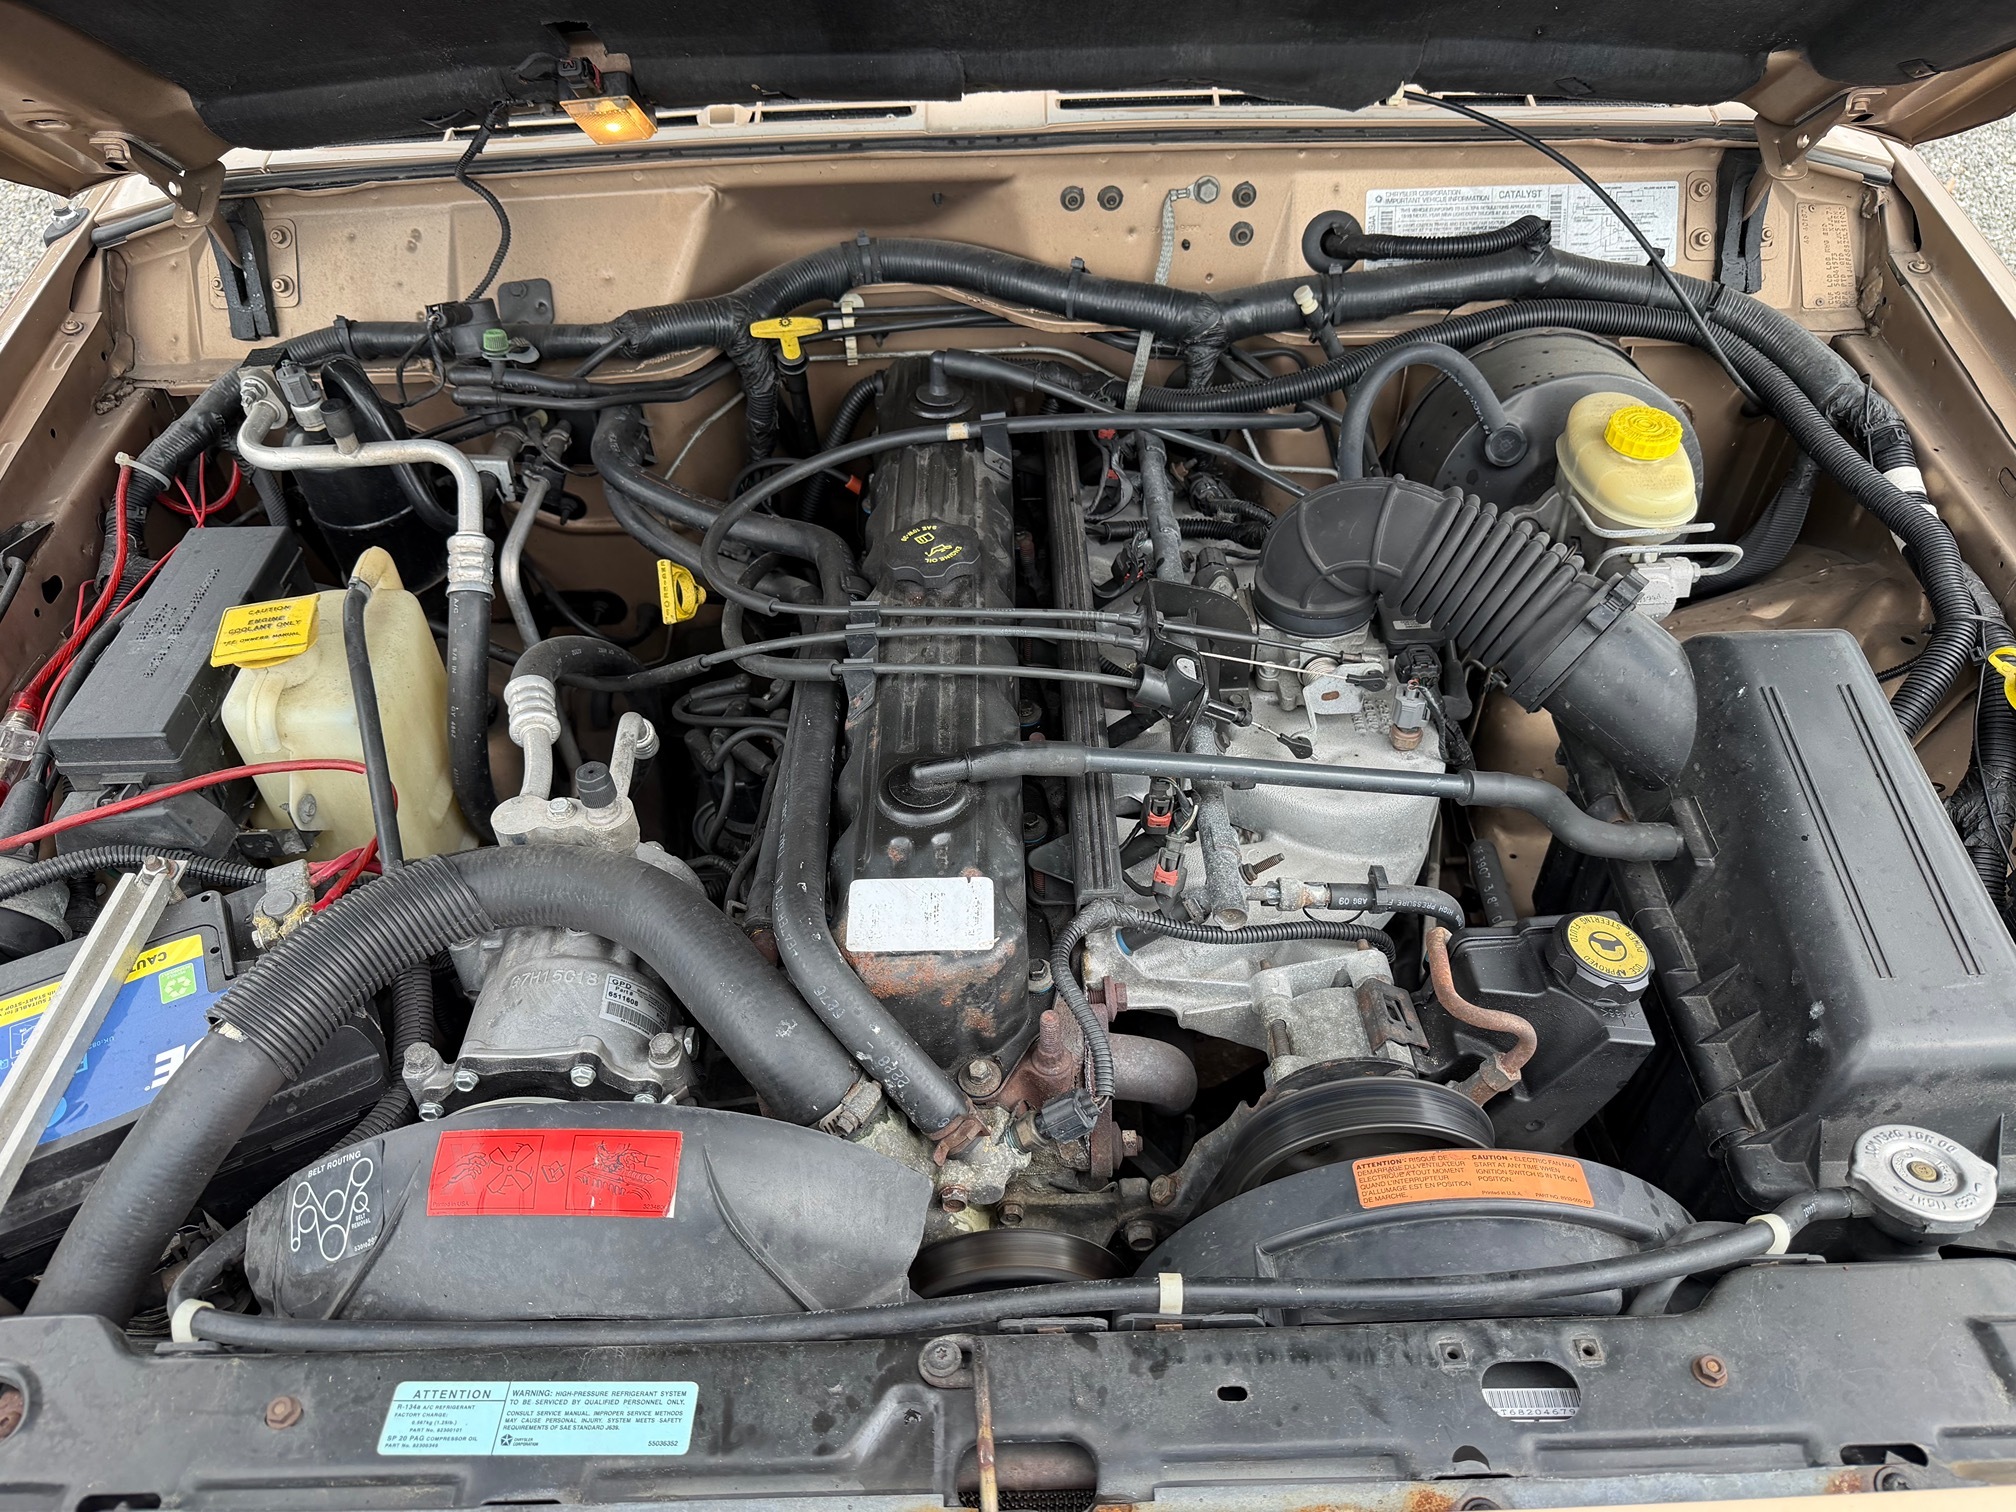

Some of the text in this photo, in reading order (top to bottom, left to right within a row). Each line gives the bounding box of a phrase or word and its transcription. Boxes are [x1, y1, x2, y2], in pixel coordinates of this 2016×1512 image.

[1446, 194, 1490, 202] INFORMATION
[1498, 190, 1542, 199] CATALYST
[938, 546, 963, 562] ENGINE
[248, 605, 293, 616] CAUTION
[247, 615, 286, 625] ENGINE
[228, 619, 302, 635] COOLANT ONLY
[239, 635, 270, 643] OWNERS
[272, 631, 301, 639] MANUAL
[1399, 900, 1436, 909] PRESSURE
[1438, 905, 1454, 915] HIGH
[1569, 917, 1645, 953] POWER STEERING FLUID
[1583, 955, 1644, 976] USE APPROVED
[611, 978, 632, 990] GPD
[608, 990, 639, 1007] 6511608
[1907, 1131, 1935, 1145] NOT
[1937, 1140, 1958, 1154] DO
[307, 1150, 361, 1178] BELT ROUTING
[1513, 1156, 1548, 1165] ELECTRIC
[1357, 1165, 1404, 1177] DEMARRAGE
[1415, 1160, 1466, 1169] VENTILATEUR
[1508, 1169, 1536, 1177] SWITCH
[1539, 1165, 1561, 1174] WHEN
[1358, 1171, 1405, 1184] ELECTRIQUE
[1360, 1174, 1450, 1190] QUAND L'INTERRUPTEUR
[1361, 1185, 1408, 1197] D'ALLUMAGE
[1436, 1180, 1472, 1188] POSITION
[1374, 1192, 1409, 1202] MARCHE.
[355, 1213, 366, 1221] BELT
[351, 1218, 372, 1229] REMOVAL
[412, 1389, 492, 1399] ATTENTION
[512, 1389, 554, 1397] WARNING:
